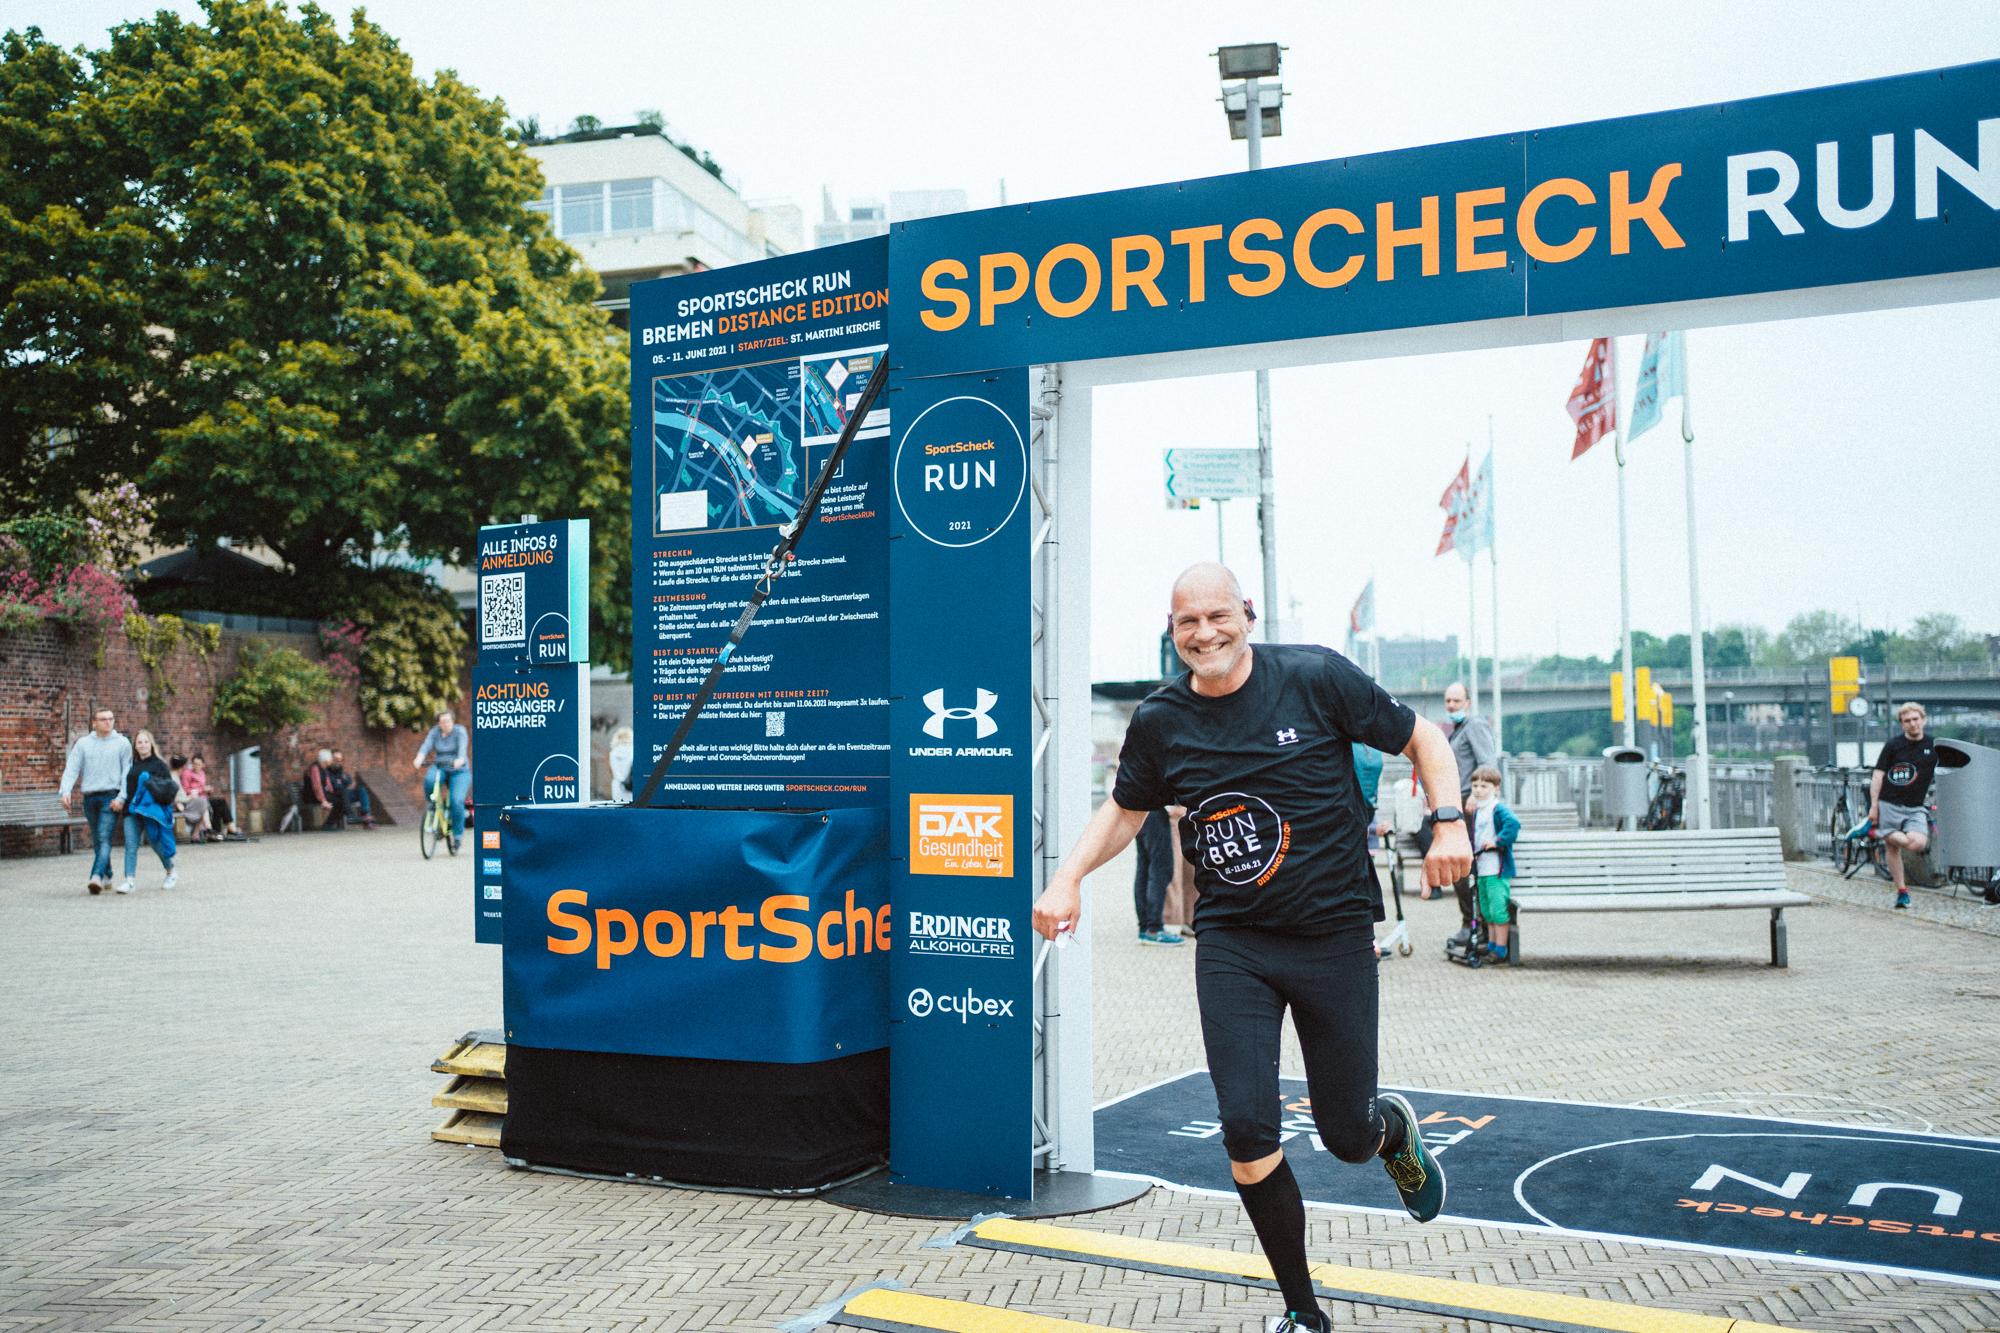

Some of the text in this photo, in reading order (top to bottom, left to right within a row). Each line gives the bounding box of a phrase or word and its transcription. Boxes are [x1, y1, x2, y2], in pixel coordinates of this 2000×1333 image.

[919, 117, 2000, 333] SPORTSCHECK RUN
[678, 270, 851, 317] SPORTSCHECK RUN
[642, 288, 889, 346] BREMEN DISTANCE EDITION
[685, 350, 706, 360] JUNI
[709, 346, 727, 357] 2021
[738, 336, 788, 352] START/ZIEL:
[790, 333, 803, 344] ST.
[806, 326, 844, 342] MARTINI
[847, 320, 881, 335] KIRCHE
[924, 440, 996, 456] SportScheck
[924, 460, 996, 492] RUN
[842, 484, 857, 492] stolz
[858, 482, 868, 490] auf
[820, 492, 866, 504] deine Leistung?
[820, 506, 832, 514] Zeig
[949, 521, 972, 530] 2021
[482, 534, 558, 556] ALLE INFOS &
[482, 550, 554, 570] ANMELDUNG
[653, 550, 693, 558] STRECKEN
[716, 554, 738, 564] Strecke
[714, 566, 727, 574] RUN
[798, 558, 820, 566] Strecke
[659, 578, 675, 586] Laufe
[711, 574, 720, 583] für
[721, 574, 730, 582] die
[740, 572, 752, 580] dich
[653, 593, 707, 602] ZEITMESSUNG
[670, 603, 706, 612] Zeitmessung
[706, 601, 728, 610] erfolgt
[780, 597, 788, 605] du
[821, 592, 870, 602] Startunterlagen
[659, 613, 683, 622] erhalten
[659, 622, 676, 630] Stelle
[696, 620, 710, 628] dass
[786, 616, 814, 624] Start/Ziel
[840, 612, 879, 620] Zwischenzeit
[539, 643, 566, 658] RUN
[682, 657, 696, 666] Chip
[744, 654, 774, 664] befestigt?
[659, 668, 677, 676] Trägst
[752, 664, 770, 672] Shirt?
[476, 682, 550, 700] ACHTUNG
[712, 692, 754, 700] ZUFRIEDEN
[807, 689, 829, 698] ZEIT?
[476, 698, 564, 714] FUSSGÄNGER /
[796, 700, 827, 708] 11.06.2021
[828, 699, 859, 708] insgesamt
[860, 698, 868, 706] 3x
[477, 714, 546, 728] RADFAHRER
[800, 743, 816, 751] daher
[846, 742, 891, 750] Eventzeitraum
[910, 748, 952, 756] UNDER
[682, 754, 706, 762] Hygiene-
[544, 785, 575, 800] RUN
[919, 804, 1003, 838] DAK
[1205, 812, 1256, 844] RUN
[920, 838, 1004, 858] Gesundheit
[1209, 834, 1262, 864] BRE
[1256, 853, 1286, 886] DISTANCE
[910, 912, 1014, 942] ERDINGER
[910, 940, 1014, 955] ALKOHOLFREI
[938, 988, 1014, 1024] cybex
